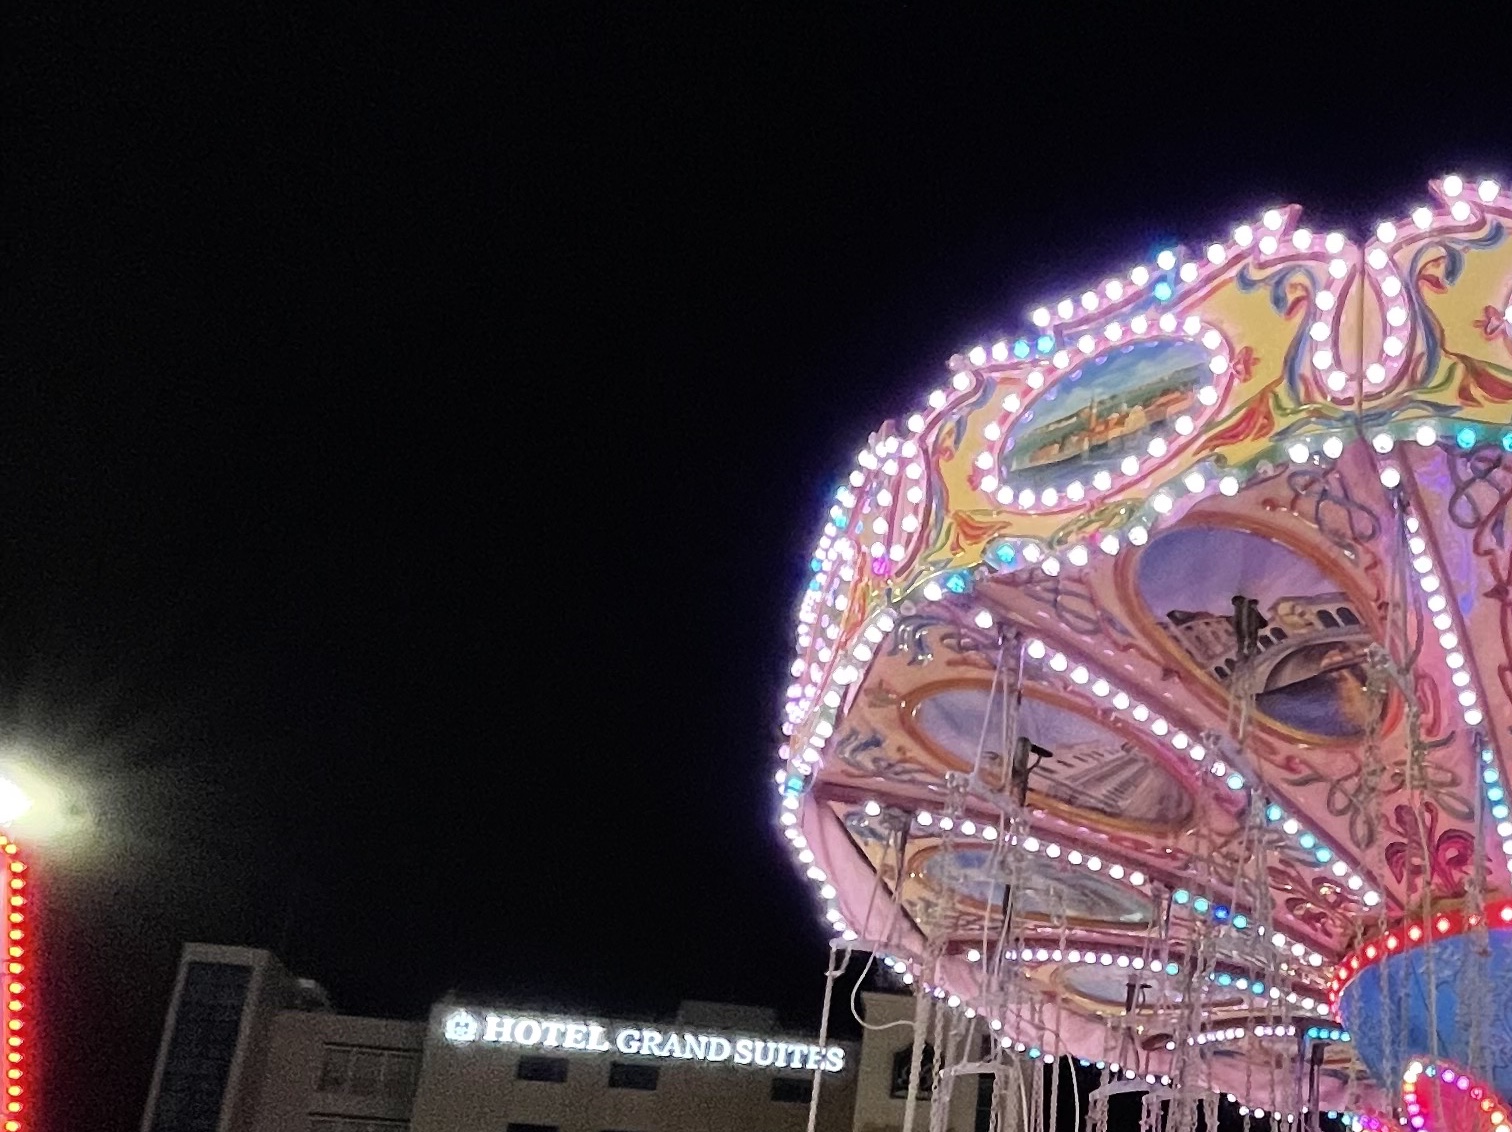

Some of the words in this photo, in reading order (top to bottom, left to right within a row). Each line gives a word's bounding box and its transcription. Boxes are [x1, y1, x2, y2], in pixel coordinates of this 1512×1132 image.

[482, 1014, 609, 1052] HOTEL
[615, 1027, 732, 1062] GRAND
[733, 1037, 846, 1073] SUITES
